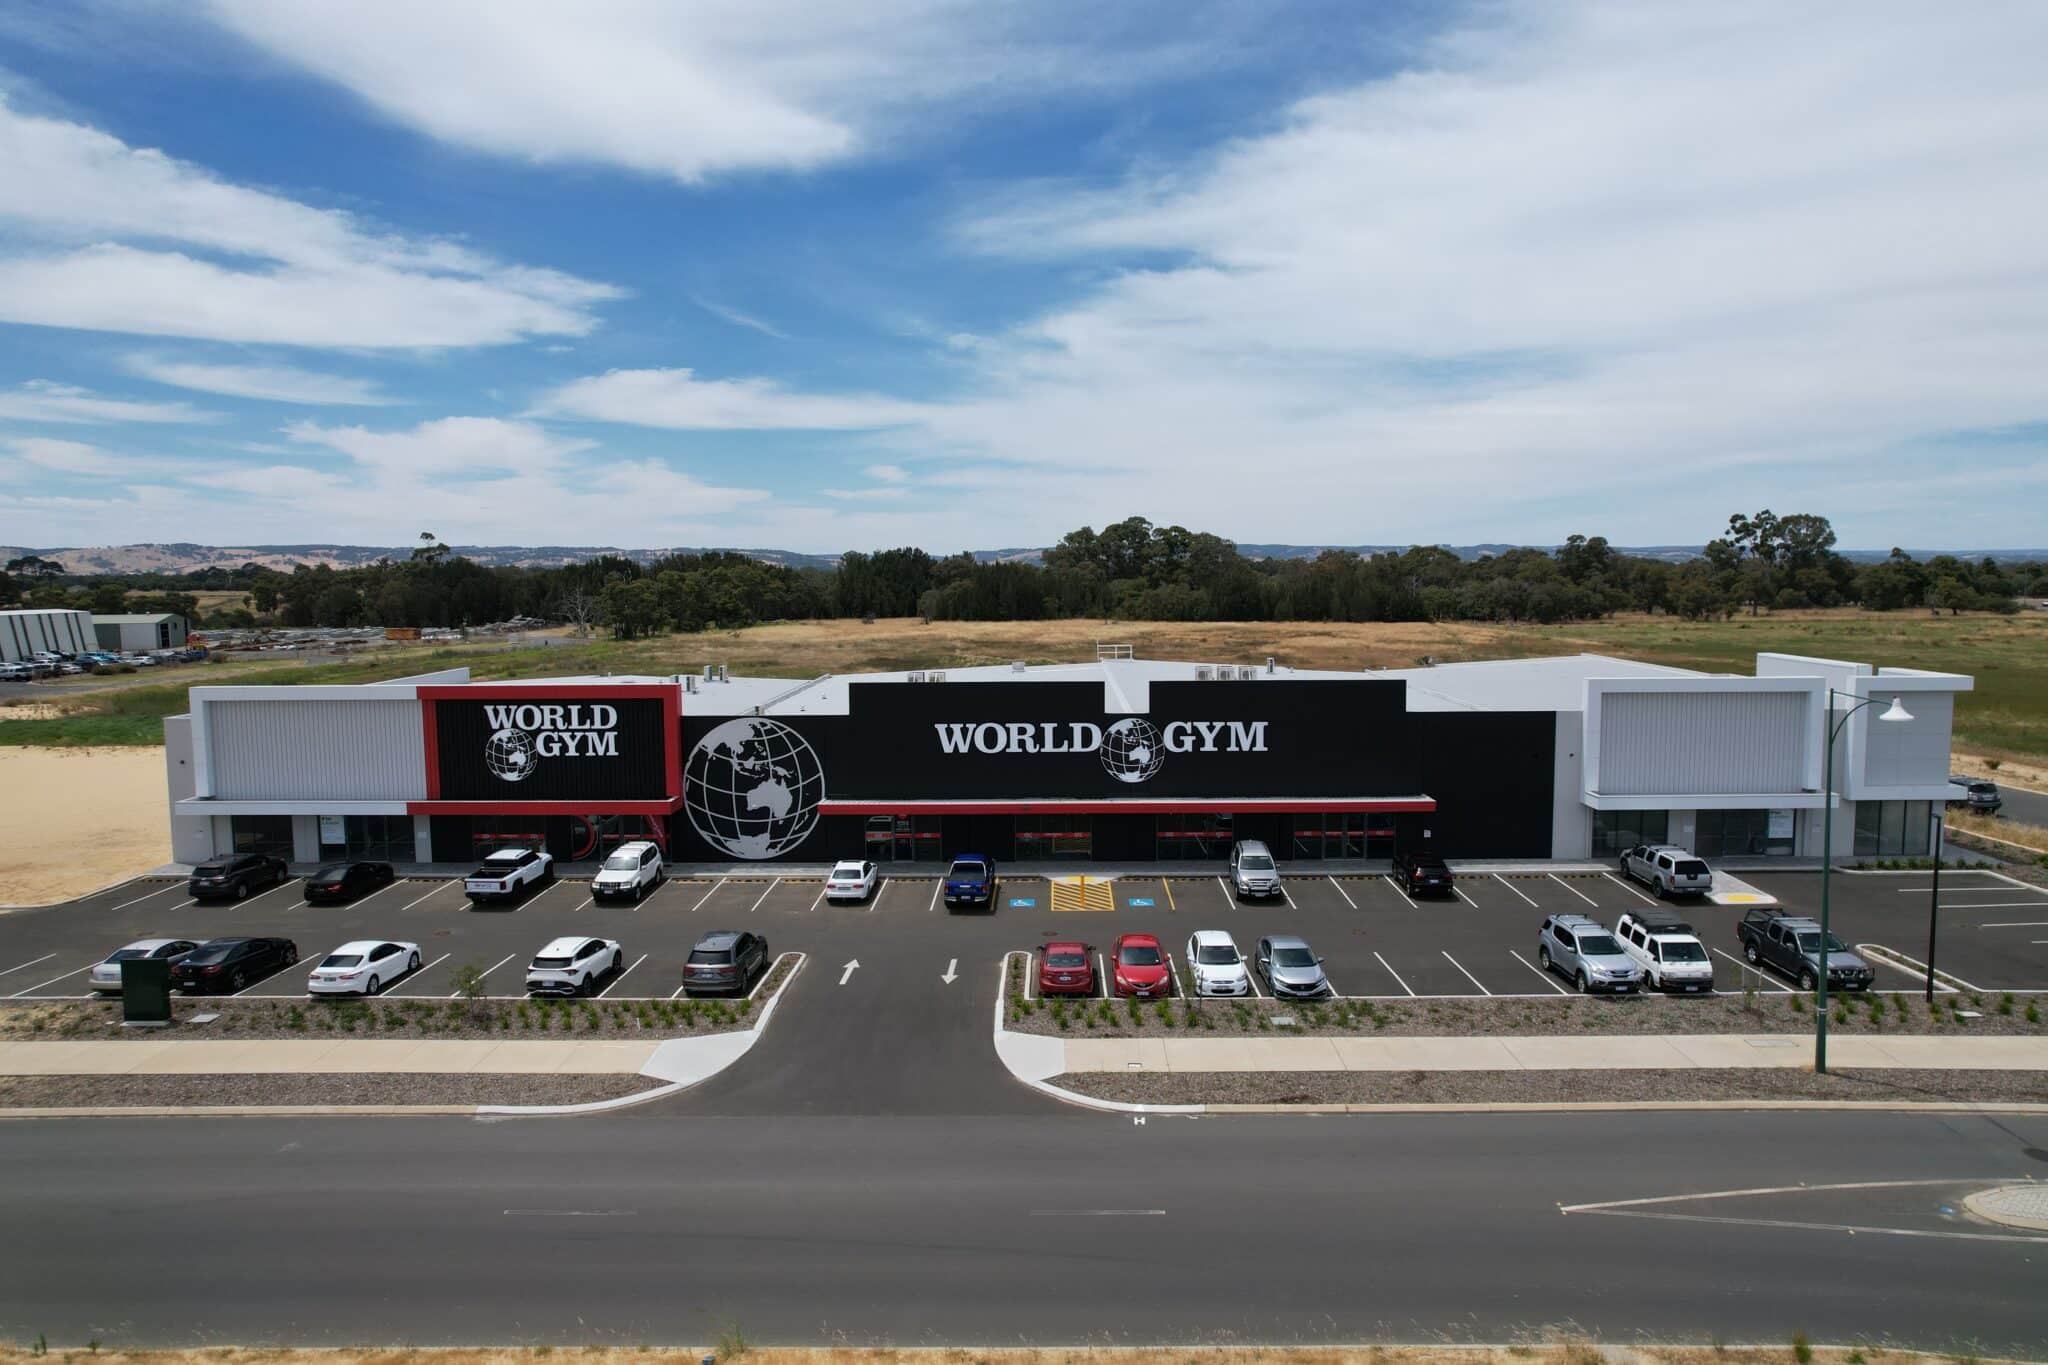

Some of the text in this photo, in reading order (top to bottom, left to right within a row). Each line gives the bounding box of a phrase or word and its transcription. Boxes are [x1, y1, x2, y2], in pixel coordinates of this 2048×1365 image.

[484, 705, 618, 730] WORLD
[536, 731, 619, 757] GYM
[935, 721, 1269, 754] WORLD GYM
